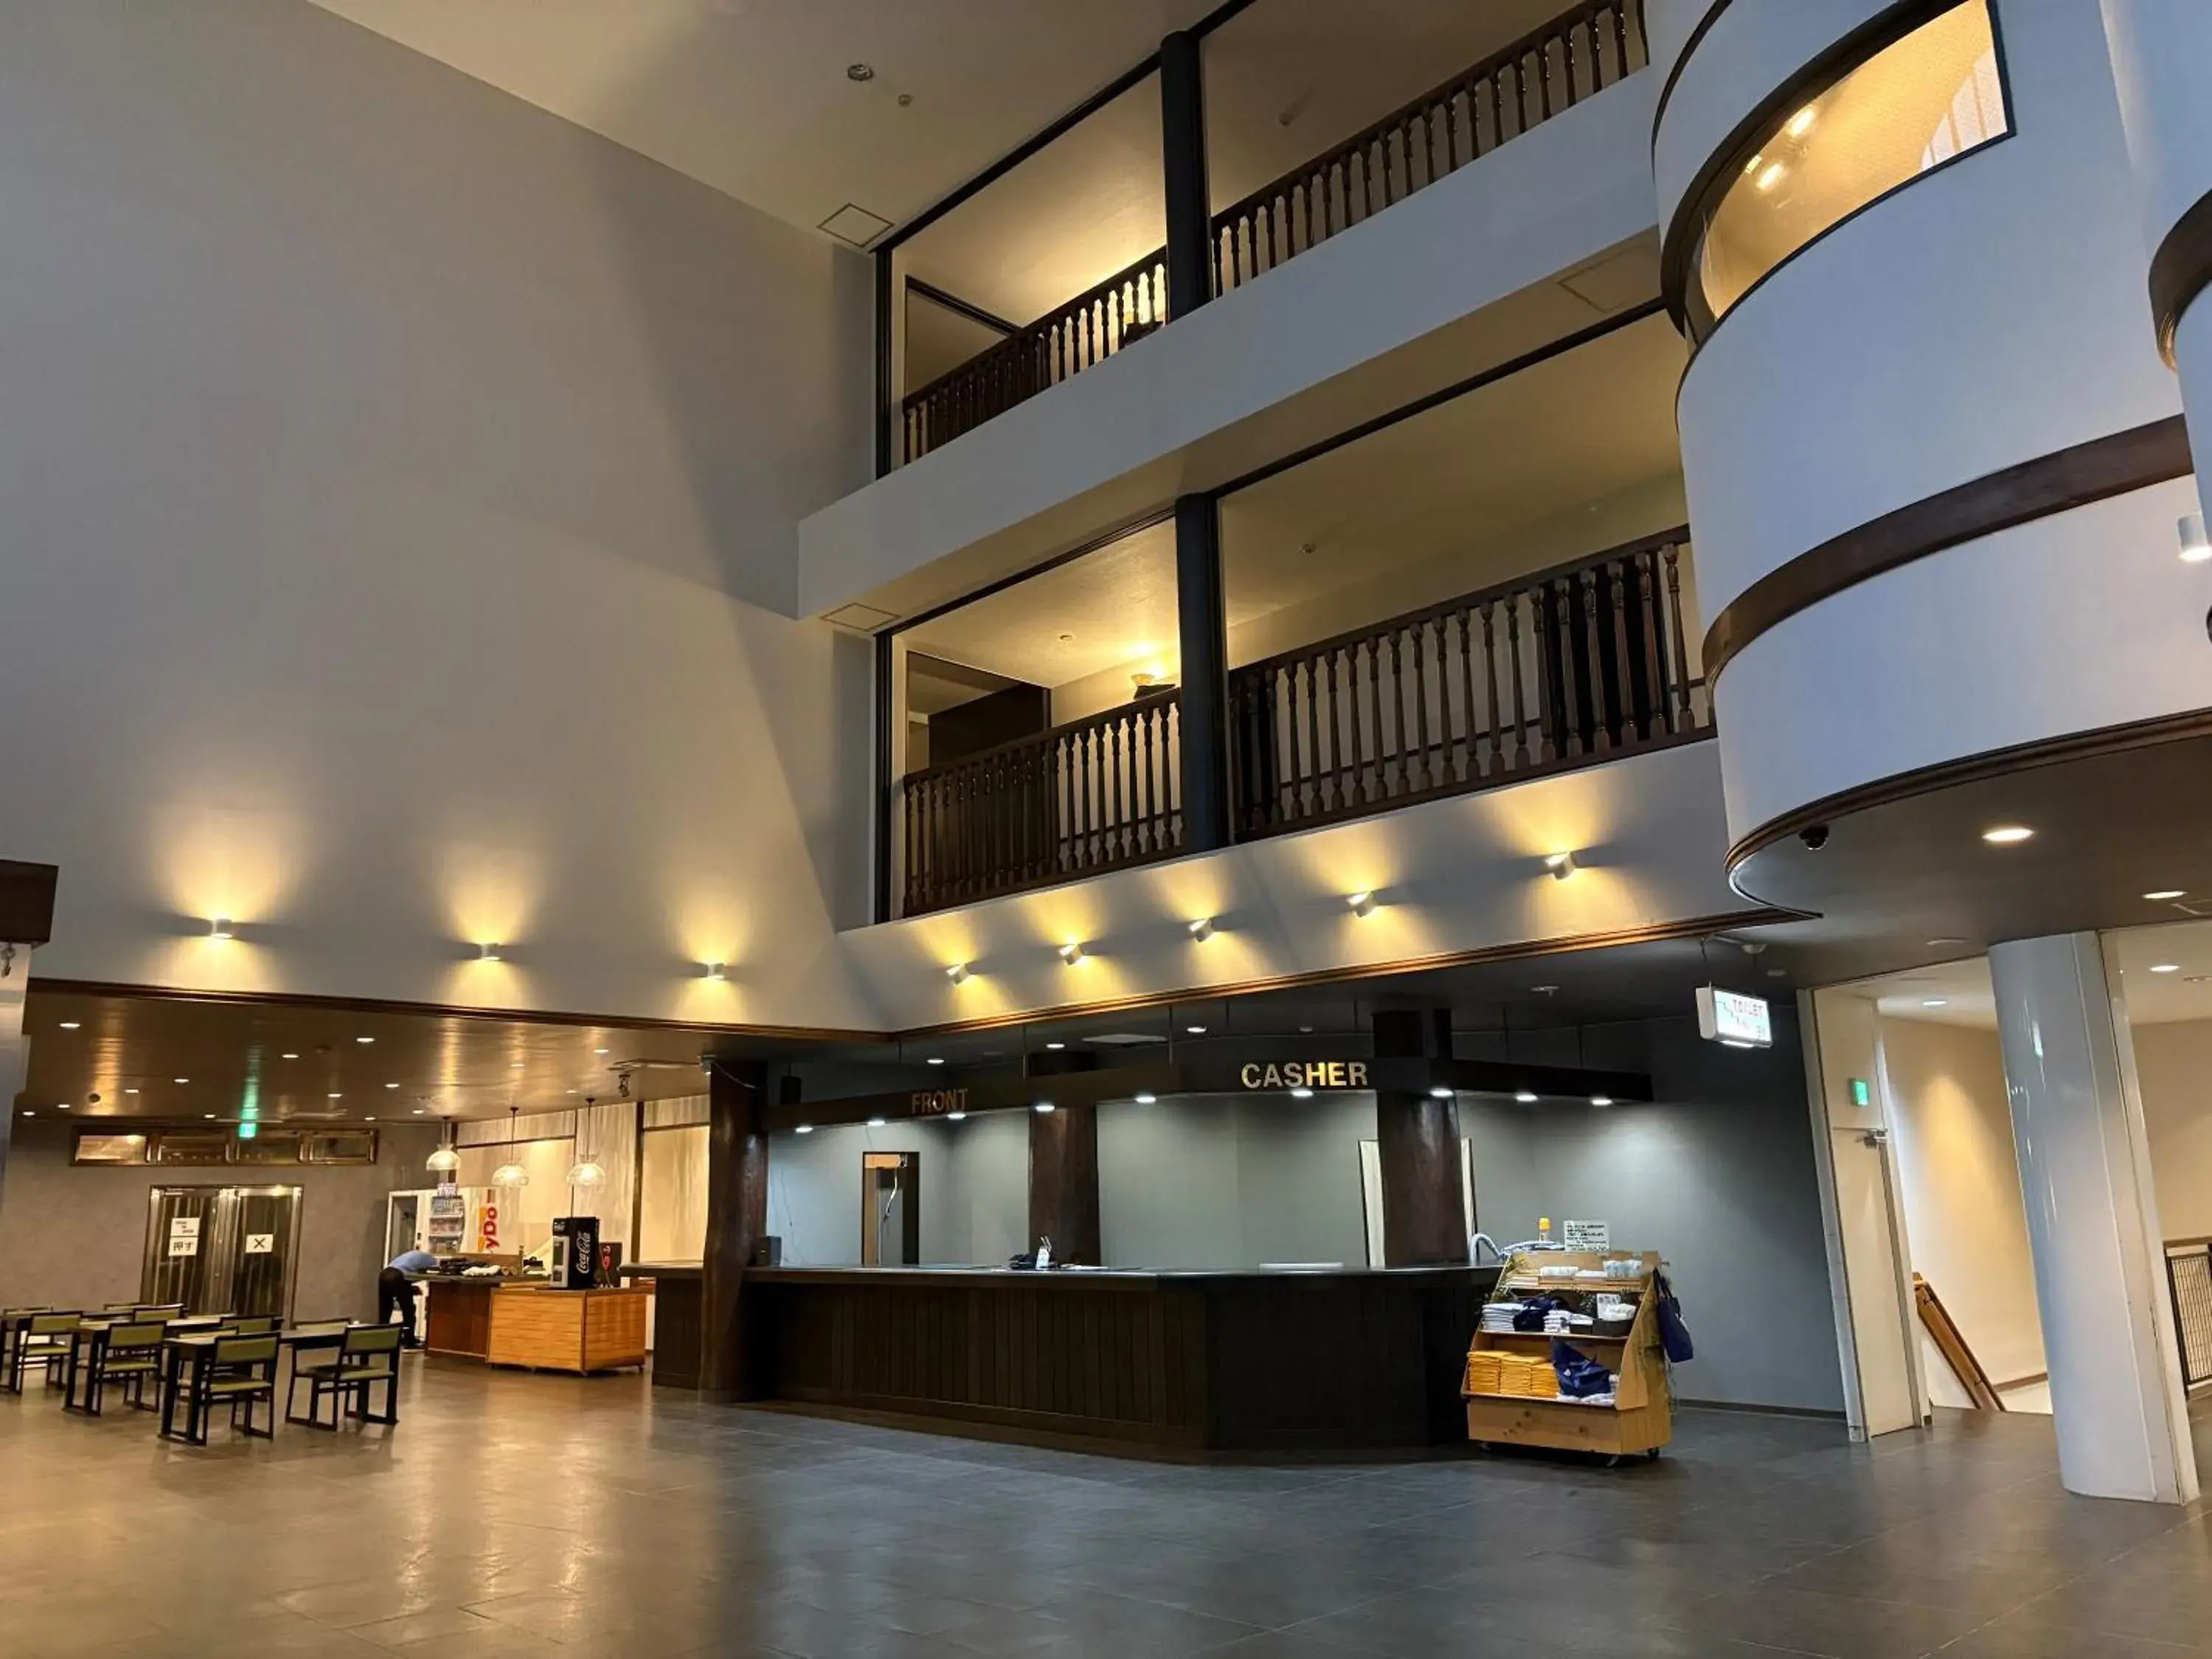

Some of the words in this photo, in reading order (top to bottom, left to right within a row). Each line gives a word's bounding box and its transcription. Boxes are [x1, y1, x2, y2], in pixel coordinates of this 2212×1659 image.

[1241, 1062, 1368, 1088] CASHER
[911, 1088, 969, 1114] FRONT
[484, 1206, 499, 1251] yDo
